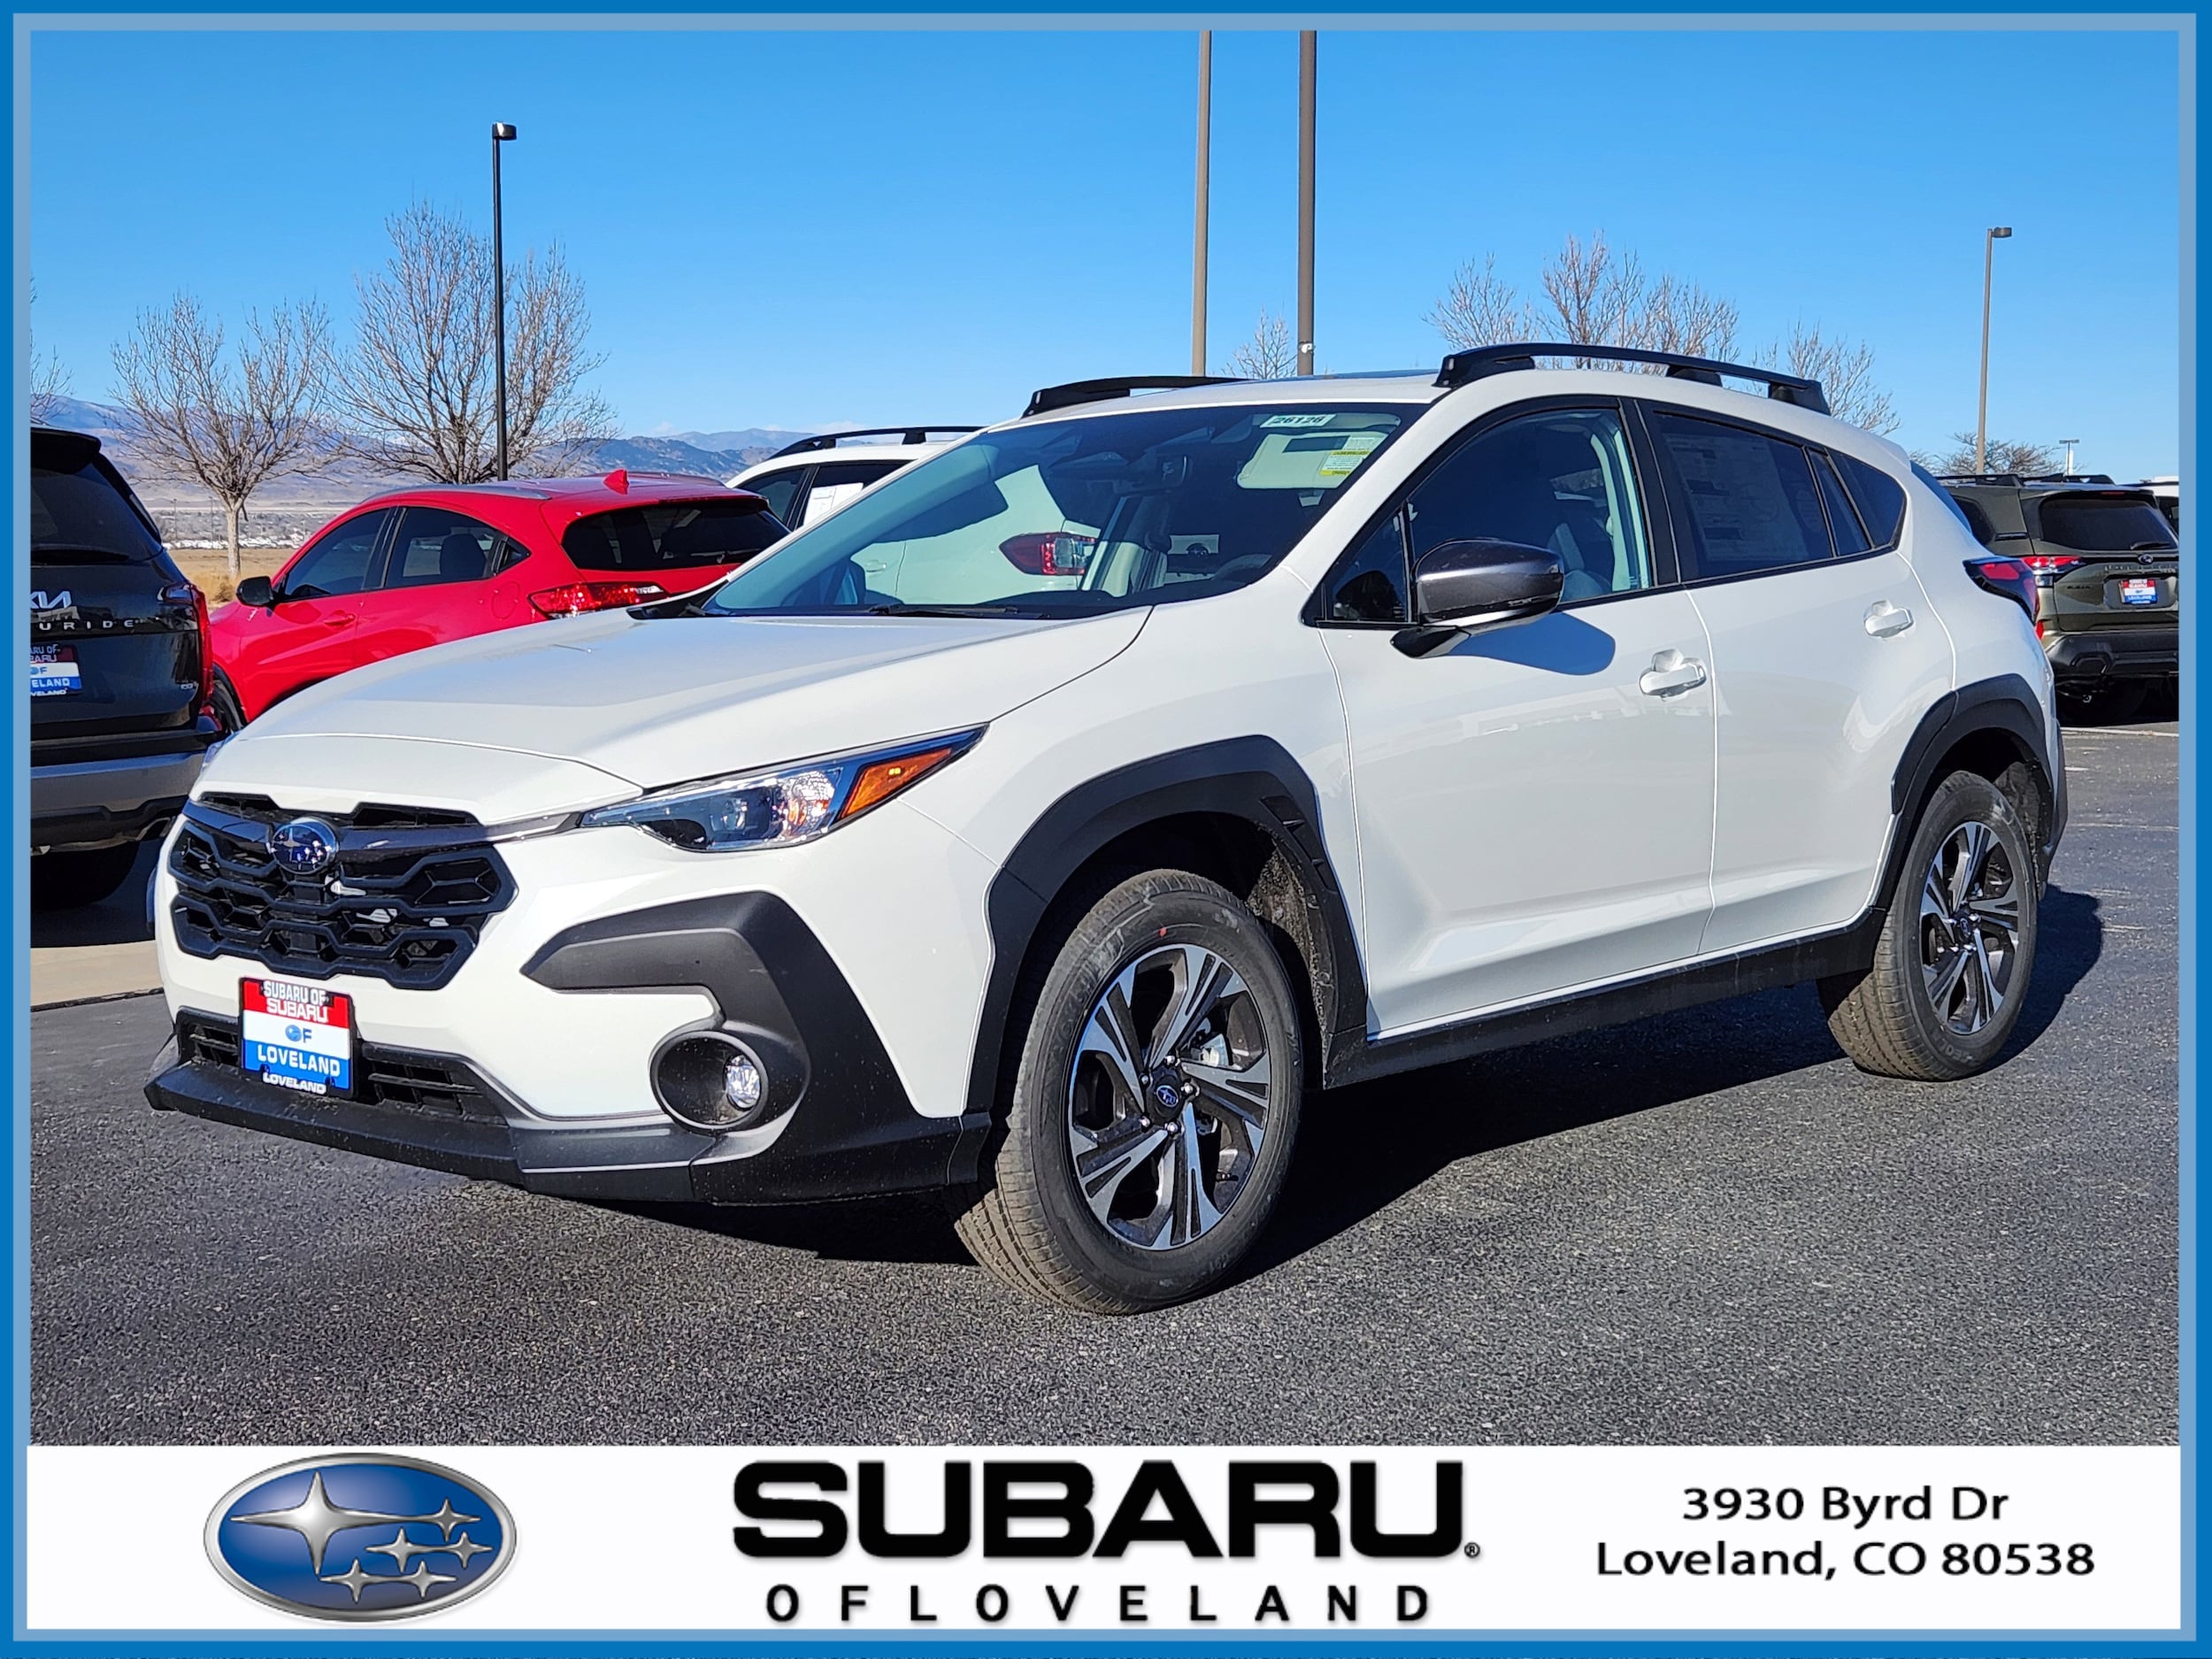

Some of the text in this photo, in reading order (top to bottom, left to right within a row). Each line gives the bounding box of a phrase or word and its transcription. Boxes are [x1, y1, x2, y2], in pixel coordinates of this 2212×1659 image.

[39, 619, 134, 630] URIDE
[31, 678, 70, 687] ELAND
[263, 980, 326, 1005] SUBARU OF
[266, 998, 328, 1023] SUBARU
[285, 1025, 311, 1043] OF
[257, 1044, 341, 1077] LOVELAND
[263, 1072, 326, 1094] LOVELAND
